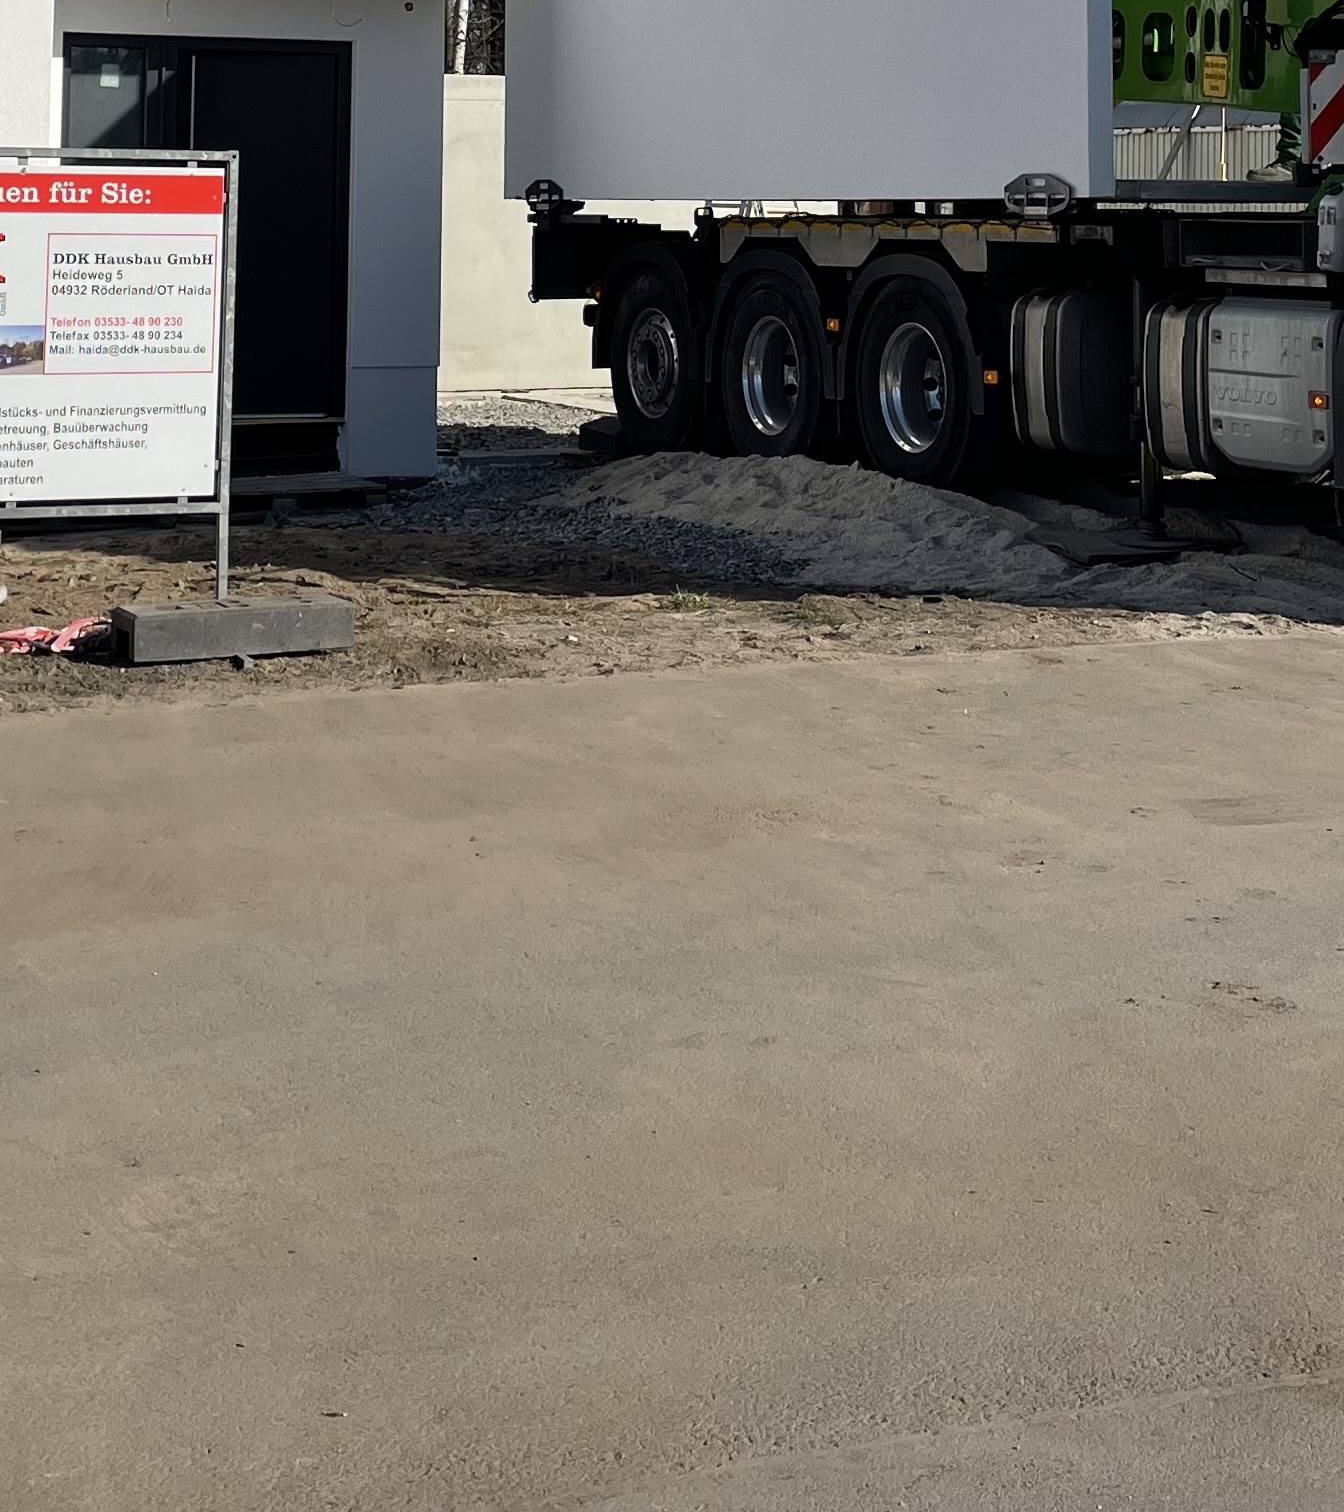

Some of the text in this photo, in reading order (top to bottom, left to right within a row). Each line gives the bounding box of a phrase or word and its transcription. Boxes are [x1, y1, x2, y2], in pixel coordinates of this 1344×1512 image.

[49, 182, 92, 203] für
[101, 182, 151, 205] Sie:
[52, 253, 214, 265] DDK Hausbau GmbH
[52, 269, 123, 282] Heideweg 5
[51, 284, 212, 296] 04932 Röderland/OT Haida
[50, 317, 91, 327] Telefon
[148, 317, 161, 326] 90
[164, 317, 183, 326] 230
[50, 331, 89, 341] Telefax
[148, 330, 161, 340] 90
[163, 330, 183, 340] 234
[49, 344, 206, 357] Mail: haida@ddk-hausbau.de
[1213, 385, 1278, 406] VOLVO
[45, 405, 66, 418] und
[69, 403, 207, 417] Finanzierungsvermittlung
[53, 421, 149, 435] Bauüberwachung
[53, 437, 148, 451] Geschäftshäuser,
